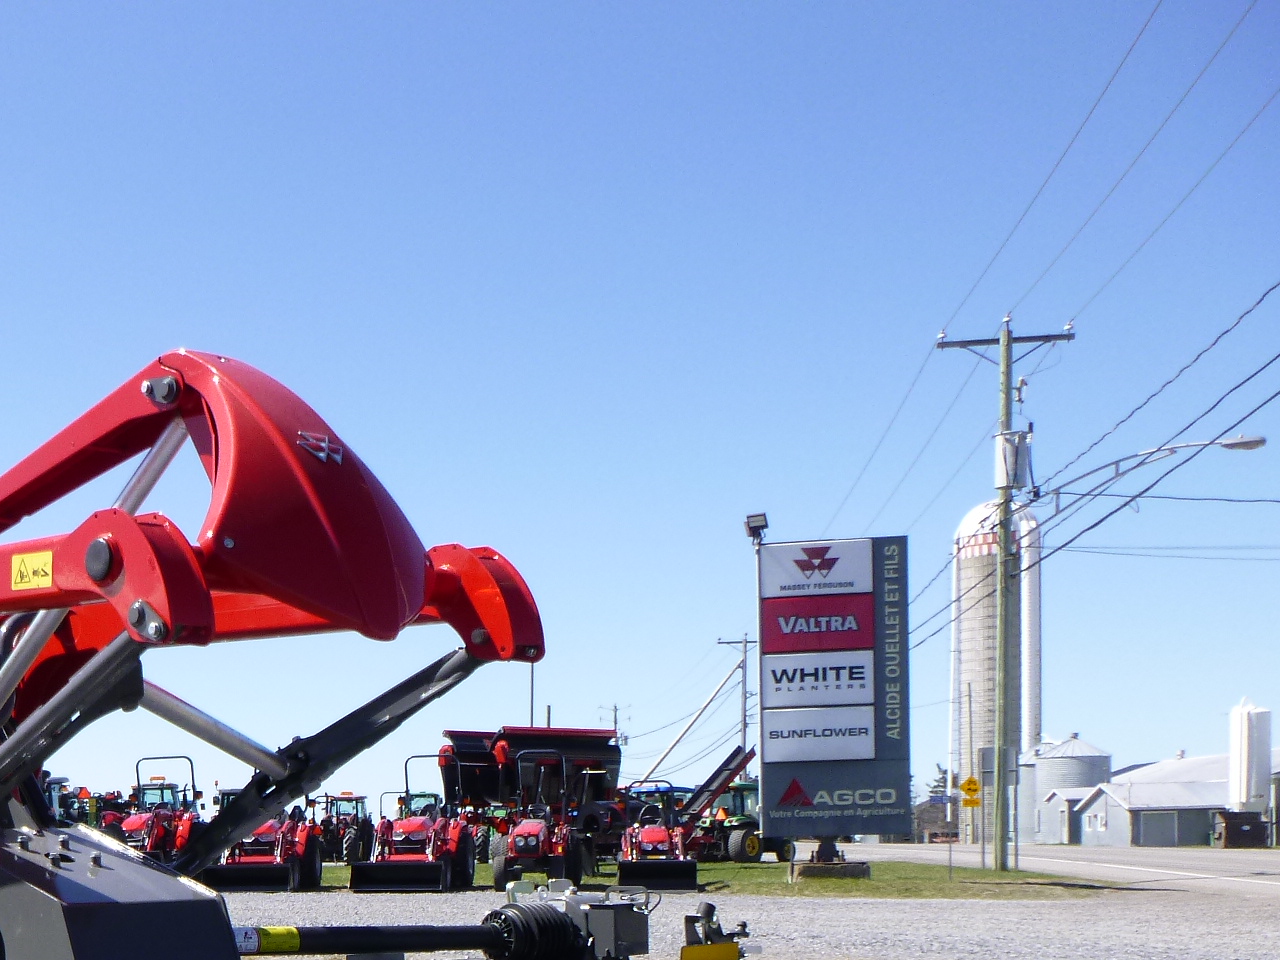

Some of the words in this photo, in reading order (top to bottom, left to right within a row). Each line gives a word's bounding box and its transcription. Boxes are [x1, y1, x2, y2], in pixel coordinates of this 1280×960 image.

[884, 544, 899, 578] FILS
[780, 584, 811, 592] MASSEY
[884, 582, 900, 602] ET
[777, 615, 859, 634] VALTRA
[884, 606, 901, 678] OUELLET
[770, 665, 866, 684] WHITE
[775, 683, 866, 692] PLANTERS
[885, 682, 901, 740] ALCIDE
[769, 727, 869, 740] SUNFLOWER
[812, 788, 897, 806] AGCO
[769, 809, 793, 819] Votre
[794, 808, 842, 819] Compagnie
[843, 808, 855, 817] en
[856, 807, 905, 818] Agriculture
